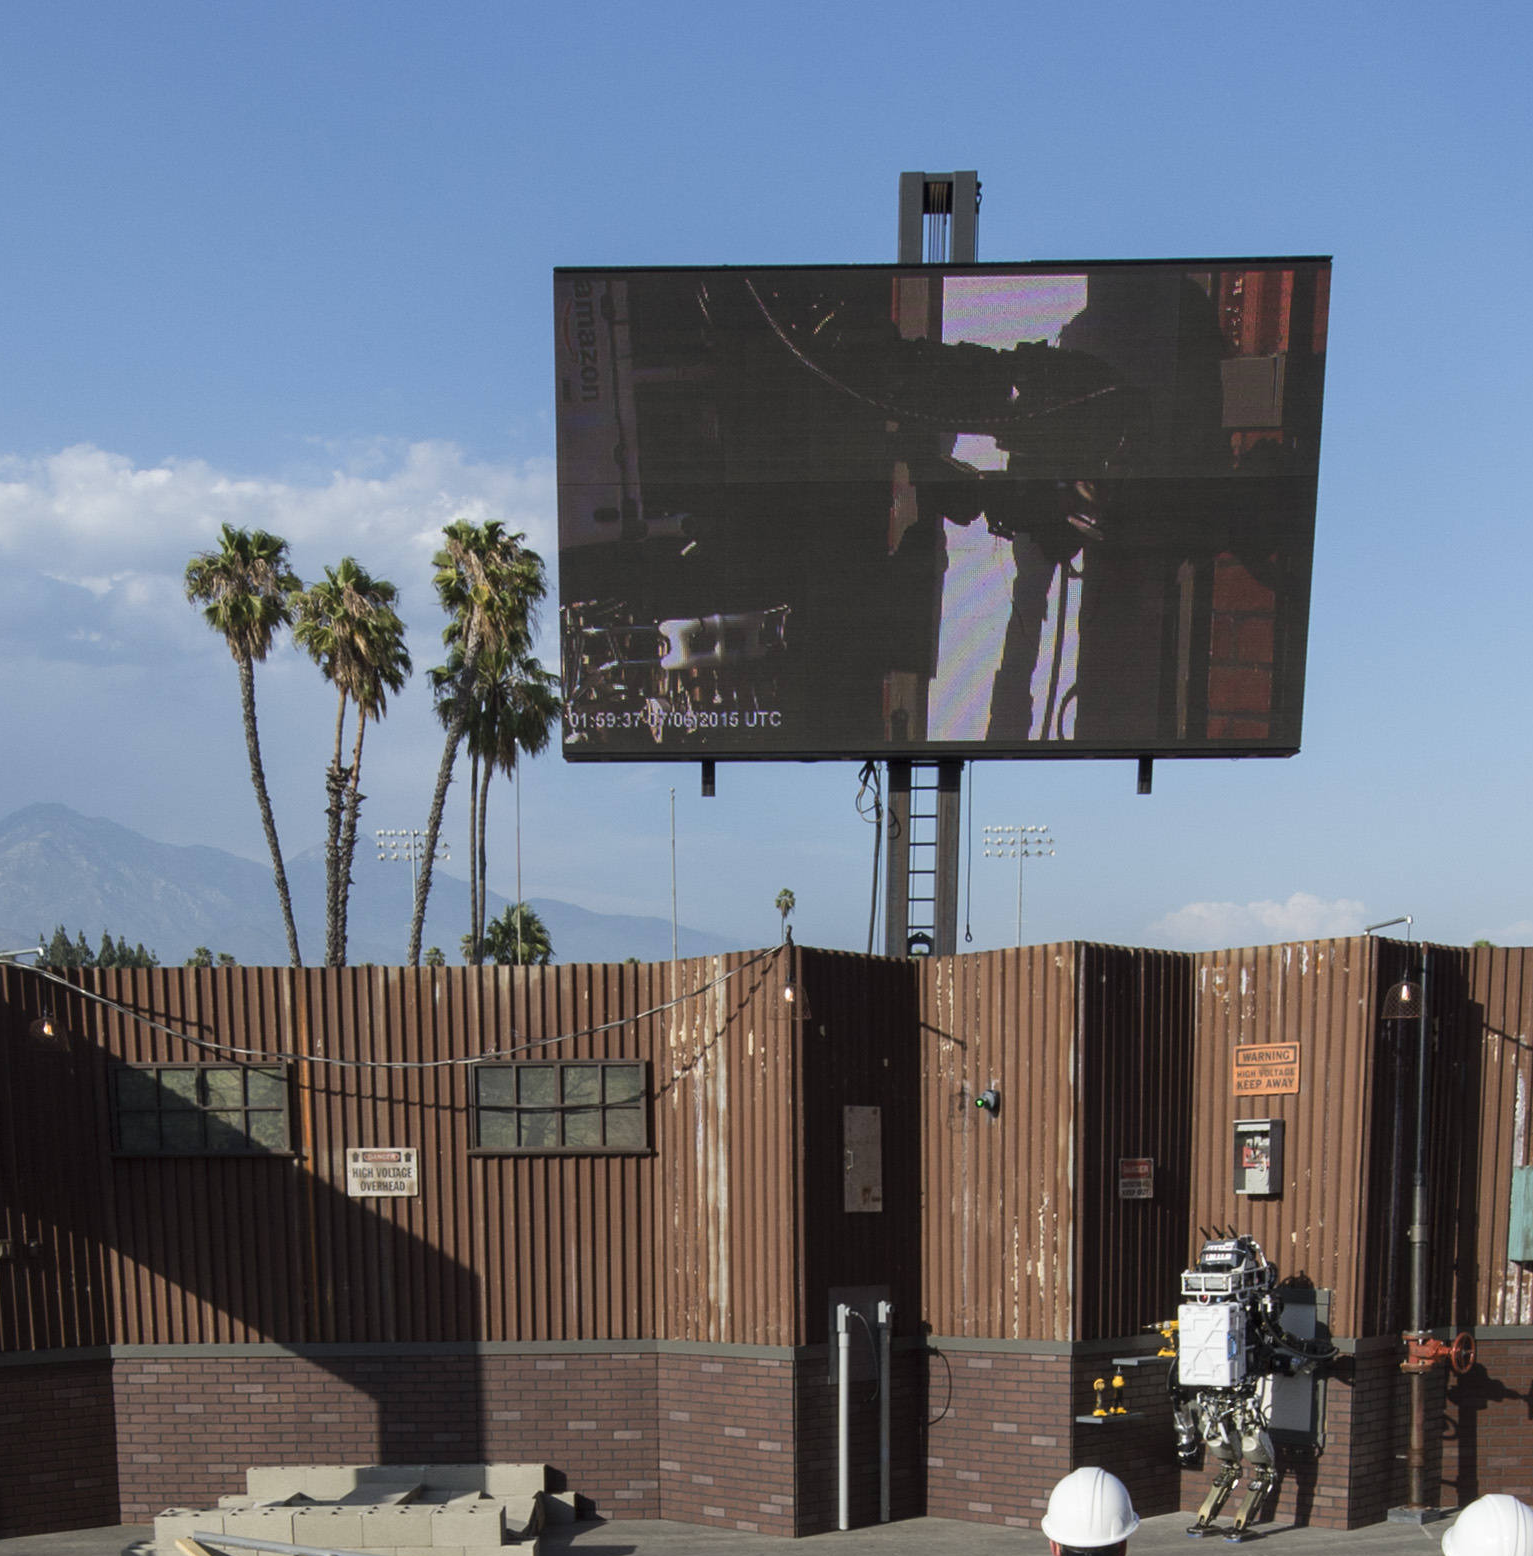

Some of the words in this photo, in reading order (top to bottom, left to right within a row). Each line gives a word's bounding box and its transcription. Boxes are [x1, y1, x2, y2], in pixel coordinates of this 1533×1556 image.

[574, 279, 599, 402] amazon
[570, 712, 640, 728] 01:59:37
[745, 712, 782, 727] UTC
[1243, 1050, 1289, 1062] WARNING
[1237, 1069, 1256, 1078] HIGH
[1259, 1067, 1295, 1077] VOLTAGE
[1237, 1080, 1262, 1090] KEEP
[1266, 1078, 1295, 1088] AWAY
[352, 1167, 373, 1178] HIGH
[376, 1167, 412, 1178] VOLTAGE
[360, 1181, 405, 1191] OVERHEAD
